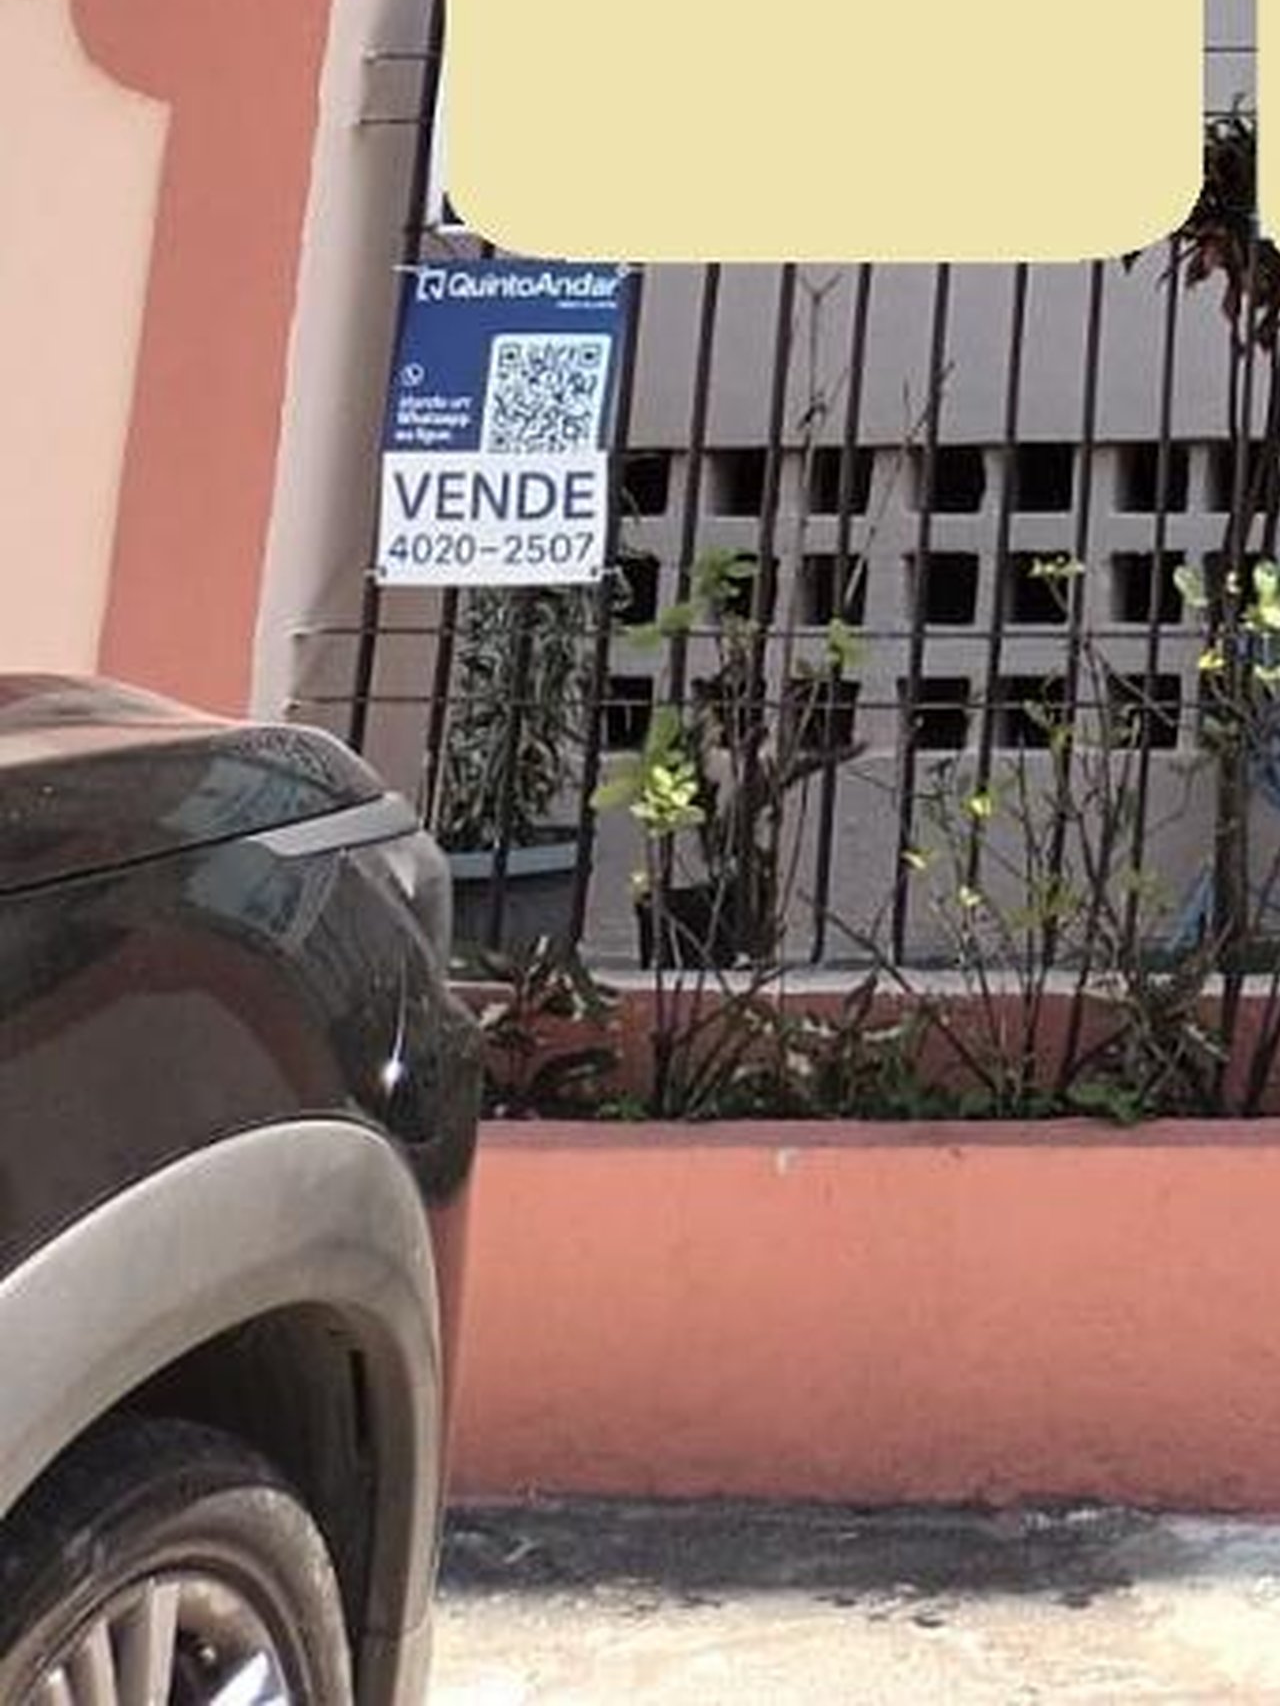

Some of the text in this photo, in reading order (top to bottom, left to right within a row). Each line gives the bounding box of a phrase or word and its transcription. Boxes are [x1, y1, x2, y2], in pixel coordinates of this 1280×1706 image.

[450, 272, 619, 300] QuintoAndar
[394, 472, 596, 522] VENDE
[389, 532, 595, 567] 4020-2507
